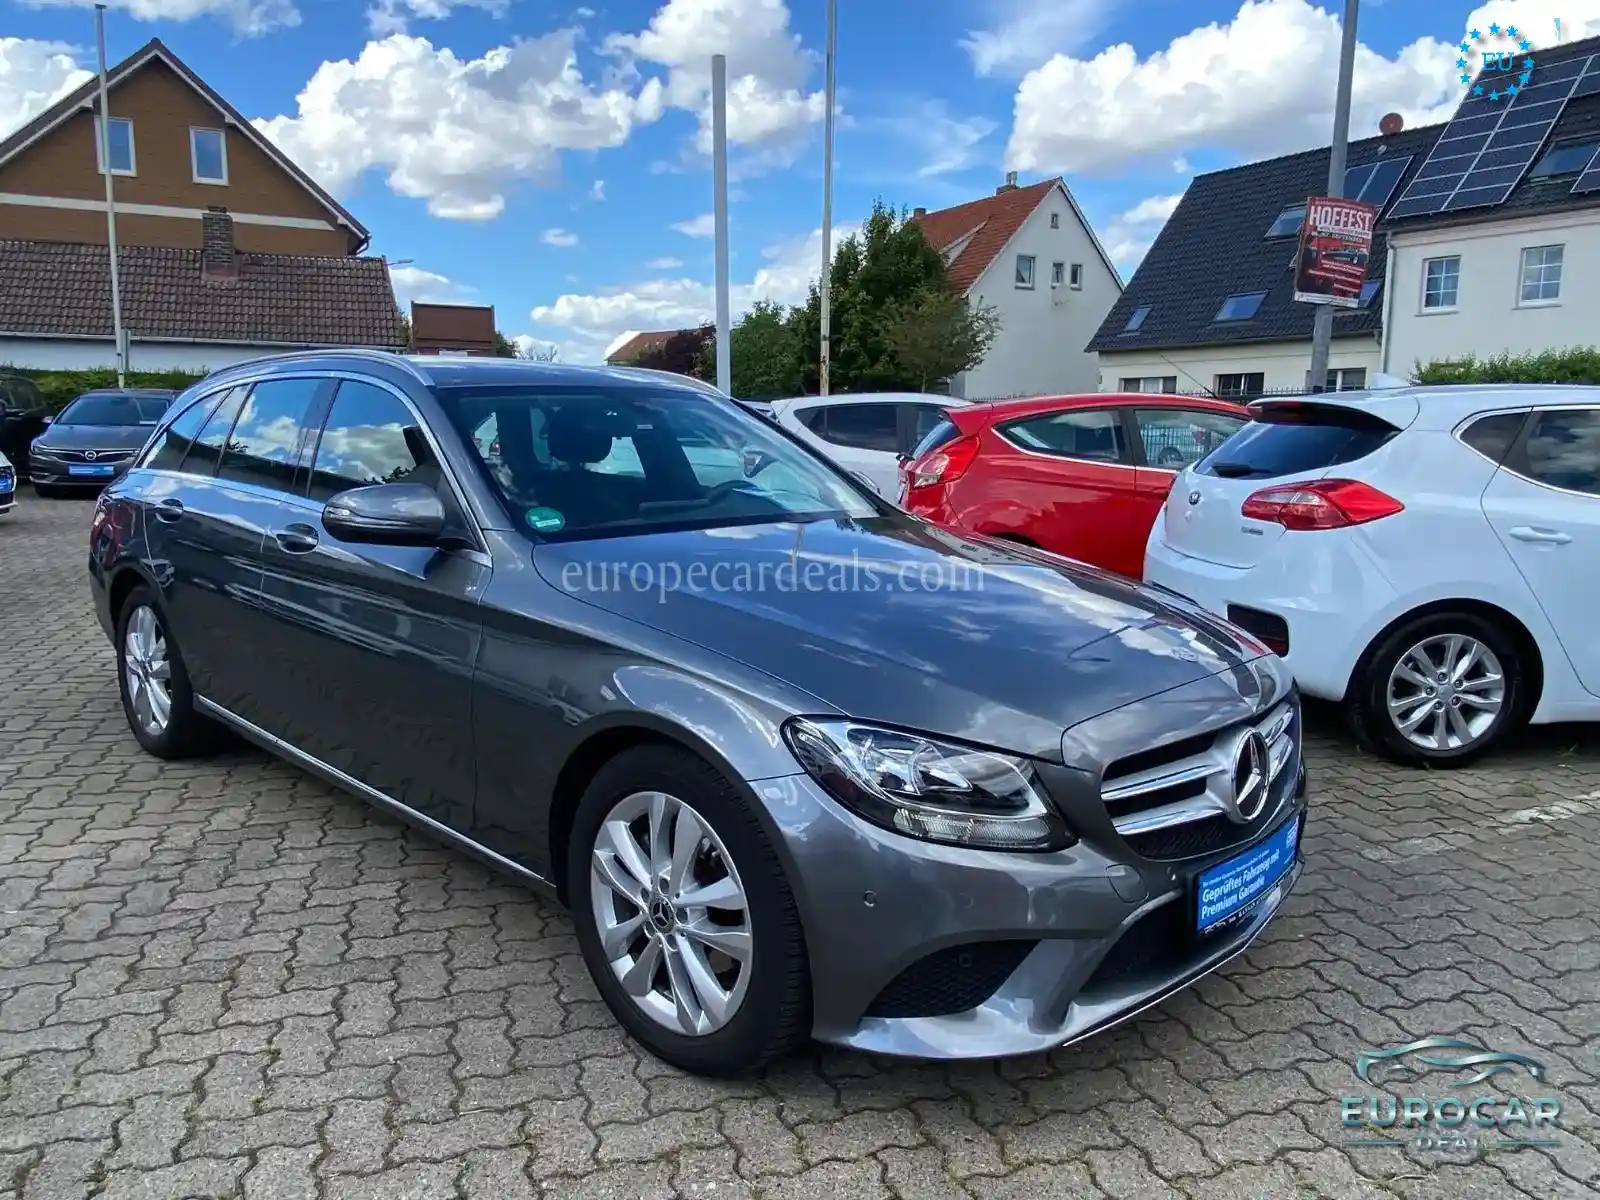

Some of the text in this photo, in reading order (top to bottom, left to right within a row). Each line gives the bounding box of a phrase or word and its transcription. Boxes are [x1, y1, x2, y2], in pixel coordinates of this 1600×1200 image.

[1310, 205, 1372, 232] HOFFEST
[1202, 877, 1242, 902] Geprüftes
[1243, 857, 1270, 882] Fahrzeug
[1201, 893, 1238, 920] Premium
